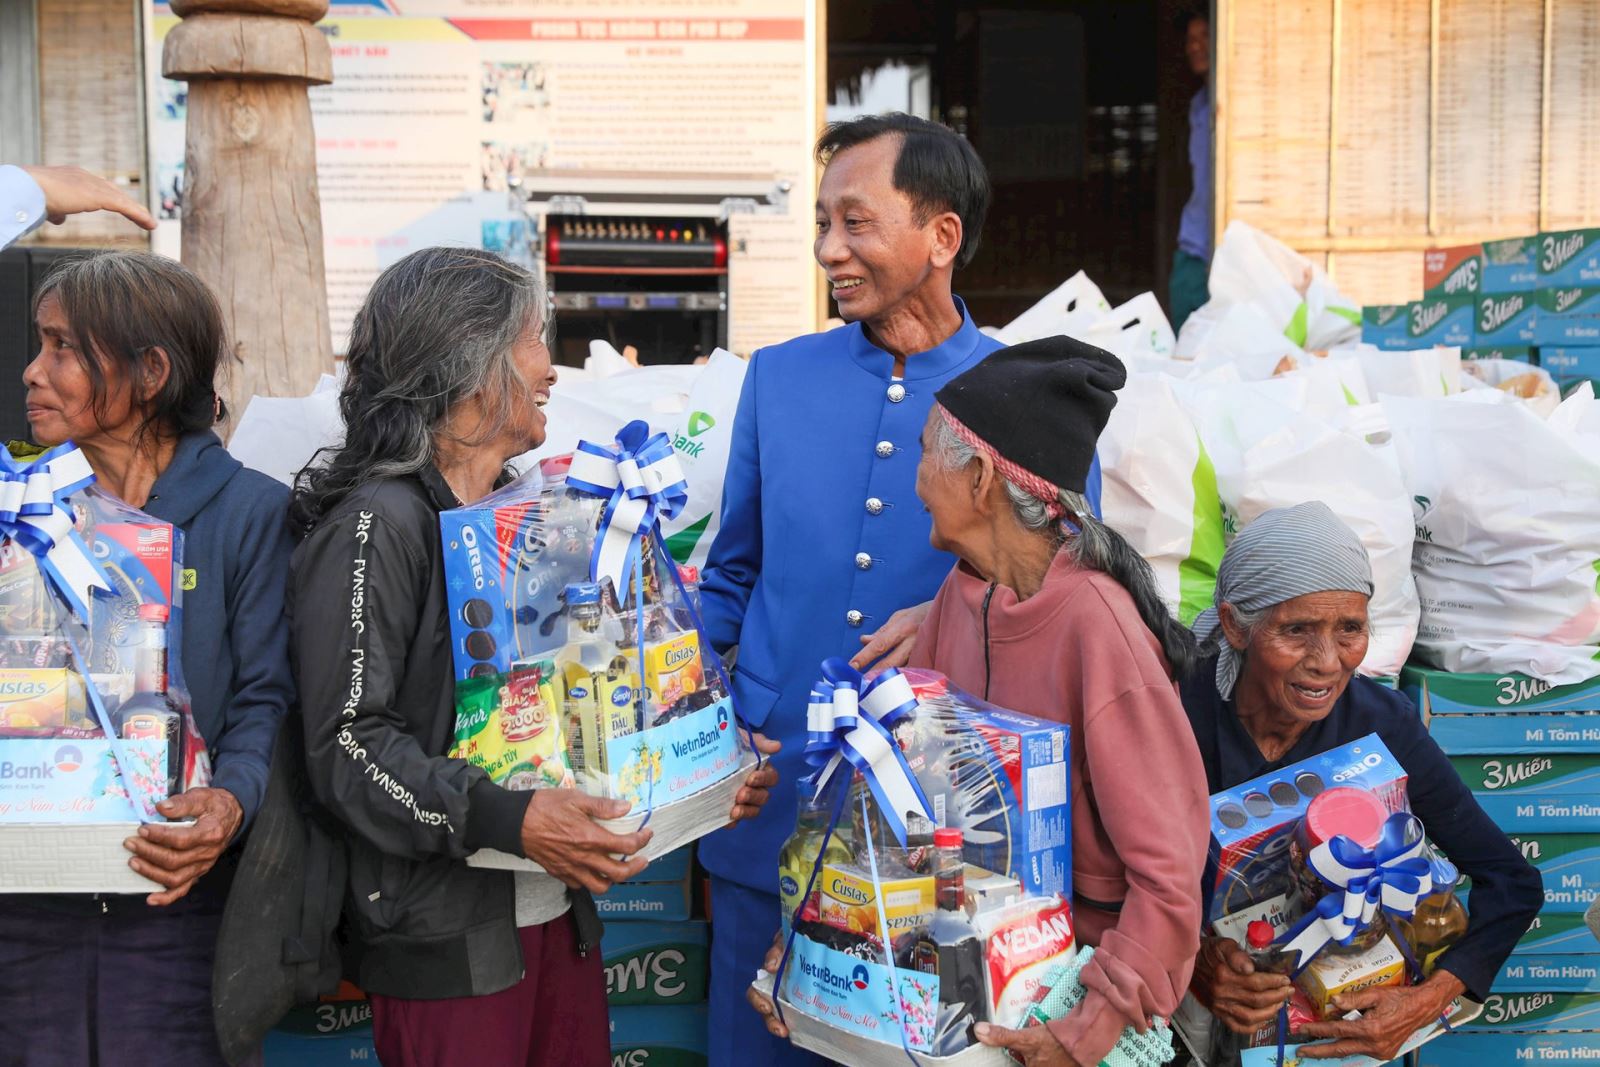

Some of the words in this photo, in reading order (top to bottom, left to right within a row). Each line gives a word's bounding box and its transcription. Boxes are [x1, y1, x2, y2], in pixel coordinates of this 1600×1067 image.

[664, 646, 695, 668] Custas
[832, 878, 870, 904] Custas
[628, 899, 665, 912] Hùm
[990, 911, 1074, 959] VEDAN
[1528, 964, 1560, 979] Tôm
[1562, 963, 1597, 979] Hùm
[1537, 1046, 1570, 1060] Tôm
